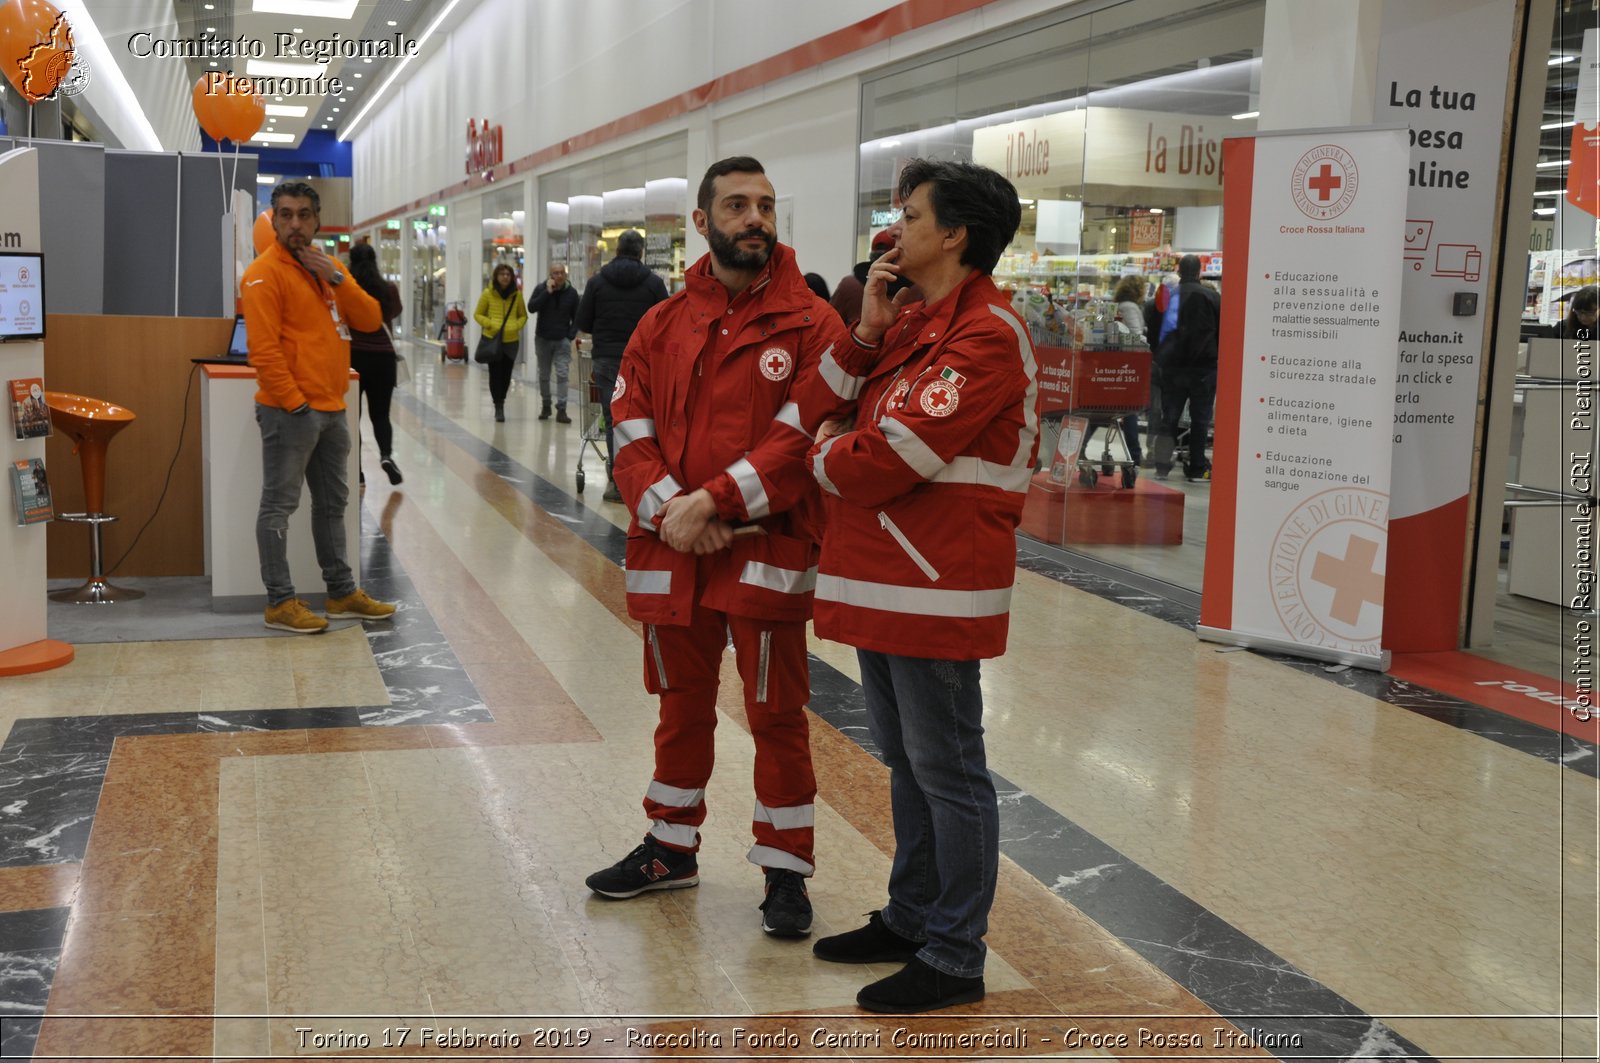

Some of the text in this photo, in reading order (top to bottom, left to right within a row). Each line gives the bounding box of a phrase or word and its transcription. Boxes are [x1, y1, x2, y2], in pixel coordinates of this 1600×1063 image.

[1390, 81, 1476, 111] La tua
[1007, 130, 1049, 179] il Dolce
[1145, 122, 1166, 173] la
[1302, 156, 1312, 168] DI
[1312, 147, 1344, 162] GINEVRA
[1280, 225, 1365, 234] Croce Rossa Italiana
[1274, 272, 1338, 282] Educazione
[1274, 286, 1379, 298] alla sessualità e
[1273, 300, 1380, 312] prevenzione delle
[1272, 314, 1380, 327] malattie sessualmente
[1272, 328, 1338, 340] trasmissibili
[1398, 331, 1464, 344] Auchan.it
[1270, 355, 1362, 370] Educazione alla
[1400, 350, 1474, 367] far la spesa
[1270, 370, 1376, 385] sicurezza stradale
[1413, 371, 1442, 384] click
[1446, 374, 1453, 384] e
[1268, 396, 1336, 410] Educazione
[1267, 411, 1372, 428] alimentare, igiene
[1266, 425, 1307, 436] e dieta
[1266, 451, 1332, 466] Educazione
[1265, 466, 1370, 484] alla donazione del
[1264, 479, 1300, 492] sangue
[1308, 499, 1330, 525] DI
[1334, 494, 1389, 525] GINE
